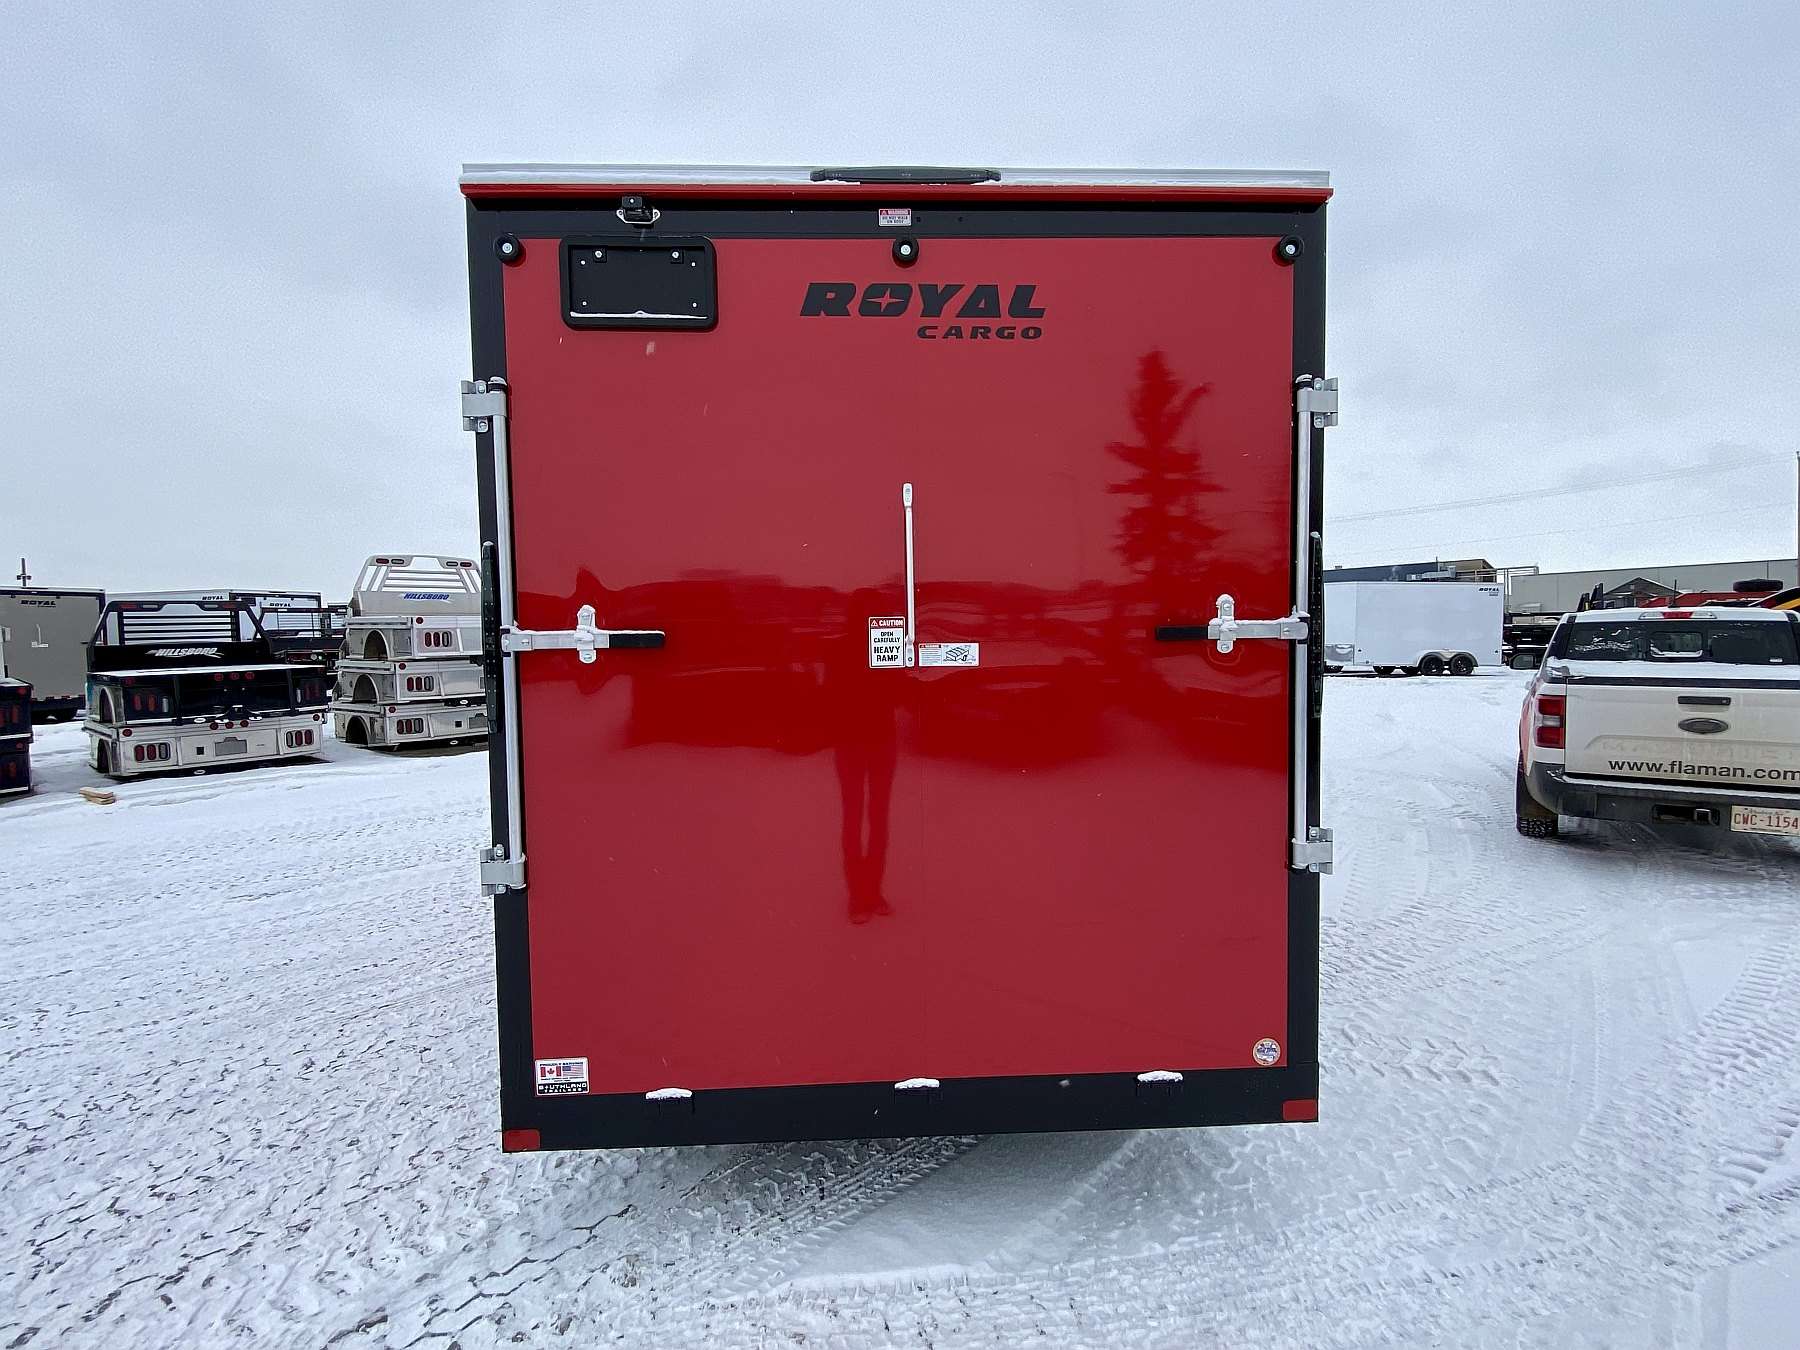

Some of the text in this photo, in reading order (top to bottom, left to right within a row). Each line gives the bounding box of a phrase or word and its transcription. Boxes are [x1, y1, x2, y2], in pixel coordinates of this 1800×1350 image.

[800, 283, 1046, 318] ROYAL
[917, 325, 1042, 339] CARGO
[404, 592, 450, 600] HILLSBORO
[155, 647, 218, 657] HILLSBORO
[873, 646, 900, 654] HEAVY
[1608, 760, 1800, 781] www.flaman.com
[1734, 812, 1799, 829] CWC-1154
